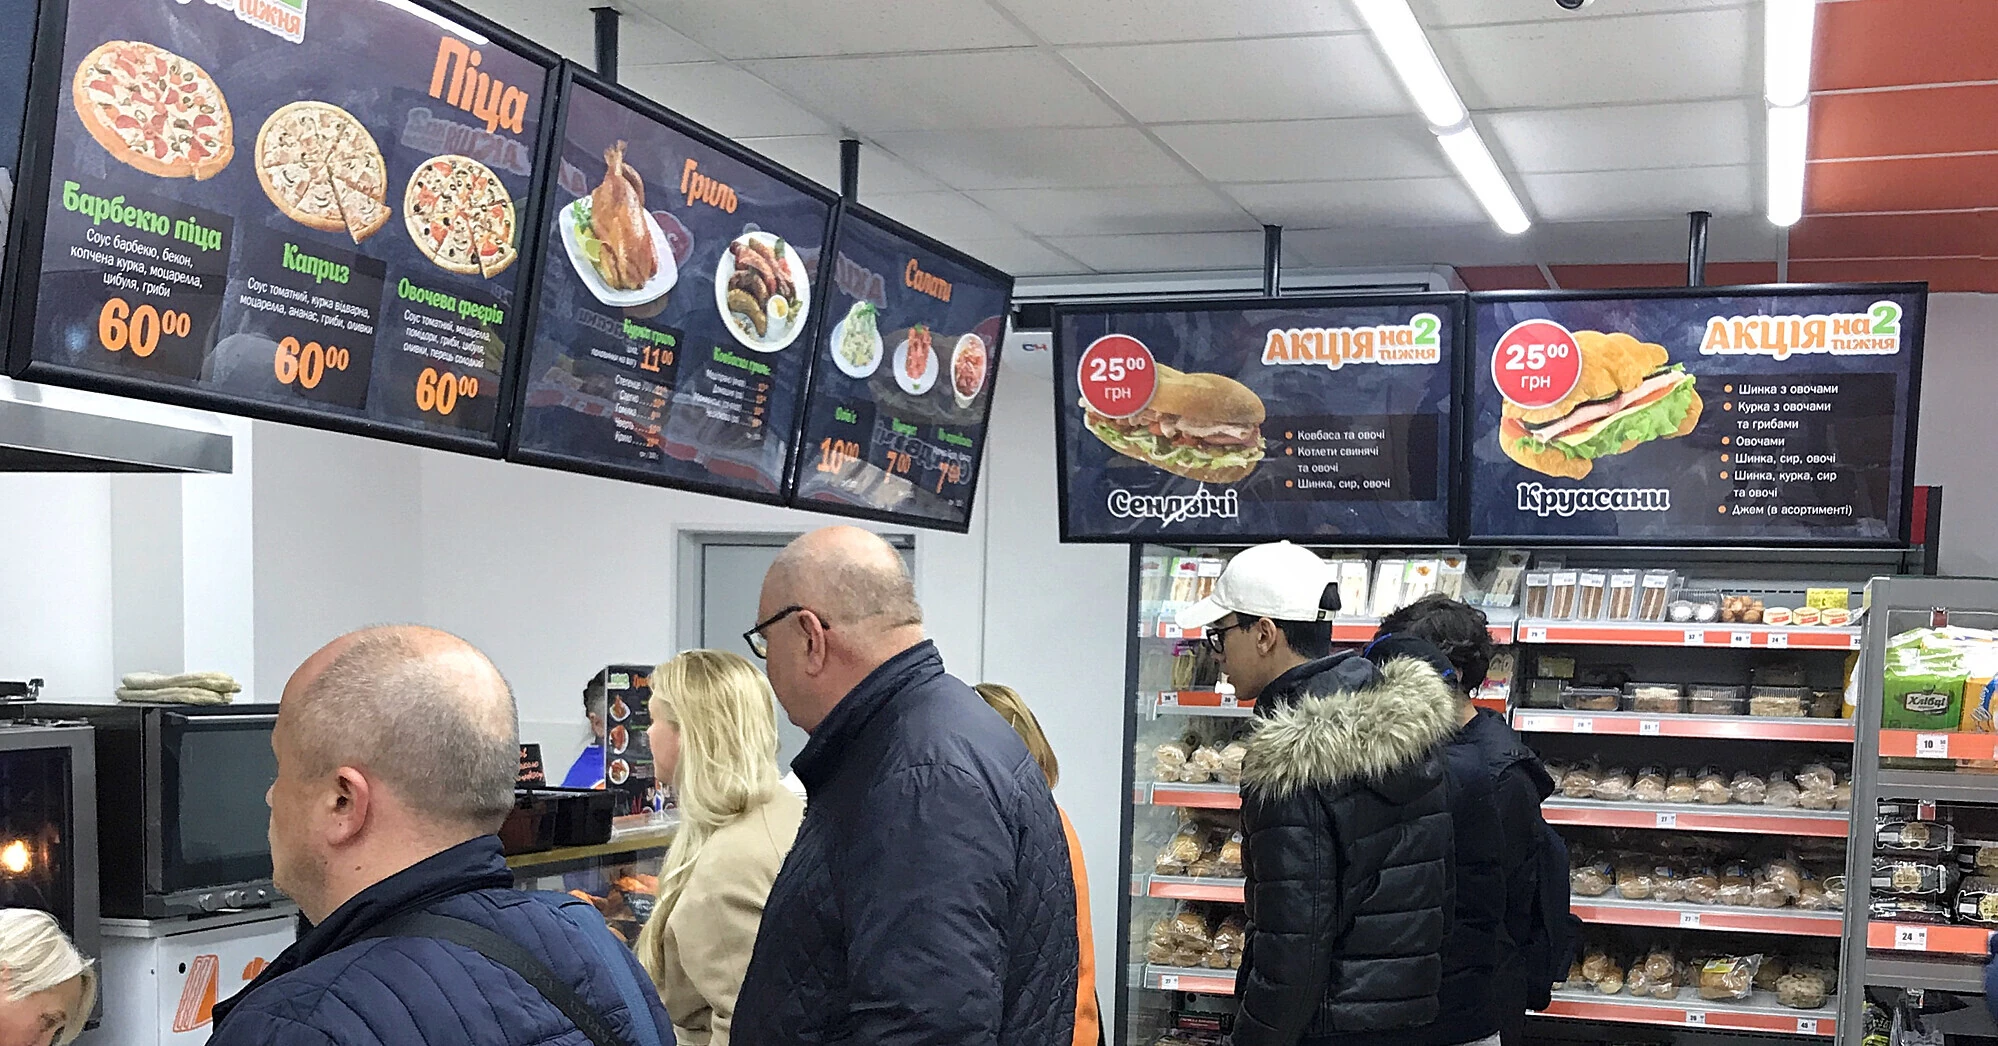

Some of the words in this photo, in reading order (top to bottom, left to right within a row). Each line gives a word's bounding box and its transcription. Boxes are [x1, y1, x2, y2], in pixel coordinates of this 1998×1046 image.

[429, 36, 529, 135] Піца
[681, 158, 738, 214] Гриль
[63, 180, 170, 236] Барбекю
[174, 216, 222, 252] піца
[86, 228, 111, 247] Соус
[113, 235, 160, 260] барбекю,
[162, 248, 194, 268] бекон,
[70, 245, 114, 266] копчена
[116, 257, 147, 275] курка,
[150, 266, 203, 289] моцарелла,
[282, 242, 350, 284] Каприз
[103, 272, 140, 291] цибуля,
[142, 281, 171, 298] гриби
[247, 277, 267, 294] Соус
[269, 283, 310, 305] томатний,
[334, 300, 371, 319] відварна,
[397, 277, 457, 312] Овочева
[458, 299, 504, 326] феєрія
[240, 294, 287, 315] моцарелла,
[288, 306, 319, 323] ананас,
[321, 314, 346, 330] гриби,
[346, 319, 374, 335] оливки
[403, 309, 421, 325] Соус
[1705, 319, 1827, 356] АКЦІЯ
[1833, 318, 1870, 335] на
[1872, 305, 1897, 335] 2
[1266, 331, 1374, 365] АКЦІЯ
[1379, 329, 1413, 346] на
[1414, 318, 1436, 345] 2
[1831, 338, 1896, 351] тижня
[1378, 349, 1436, 360] тижня
[1521, 375, 1551, 391] грн
[1738, 384, 1777, 394] Шинка
[1780, 385, 1787, 394] з
[1789, 384, 1839, 394] овочами
[1104, 387, 1132, 402] грн
[1737, 401, 1770, 414] Курка
[1773, 402, 1780, 412] з
[1783, 402, 1832, 412] овочами
[1737, 420, 1750, 429] та
[1752, 418, 1799, 431] грибами
[1297, 429, 1341, 441] Ковбаса
[1343, 431, 1355, 440] та
[1357, 429, 1385, 440] овочі
[1735, 435, 1786, 446] Овочами
[1297, 446, 1338, 457] Котлети
[1340, 446, 1379, 457] свинячі
[1735, 453, 1777, 465] Шинка,
[1779, 454, 1803, 466] сир,
[1806, 453, 1836, 464] овочі
[1297, 464, 1309, 473] та
[1311, 462, 1339, 473] овочі
[1297, 478, 1336, 489] Шинка,
[1338, 480, 1360, 490] сир,
[1363, 478, 1391, 489] овочі
[1734, 470, 1776, 482] Шинка,
[1779, 471, 1813, 483] курка,
[1816, 471, 1837, 483] сир
[1517, 482, 1670, 517] Круасани
[1733, 488, 1746, 498] та
[1748, 487, 1778, 498] овочі
[1108, 489, 1238, 522] Сендвічі
[1731, 504, 1764, 516] Джем
[1767, 505, 1778, 517] (в
[1780, 504, 1853, 517] асортименті)
[1923, 740, 1934, 749] 10
[1902, 932, 1913, 941] 24
